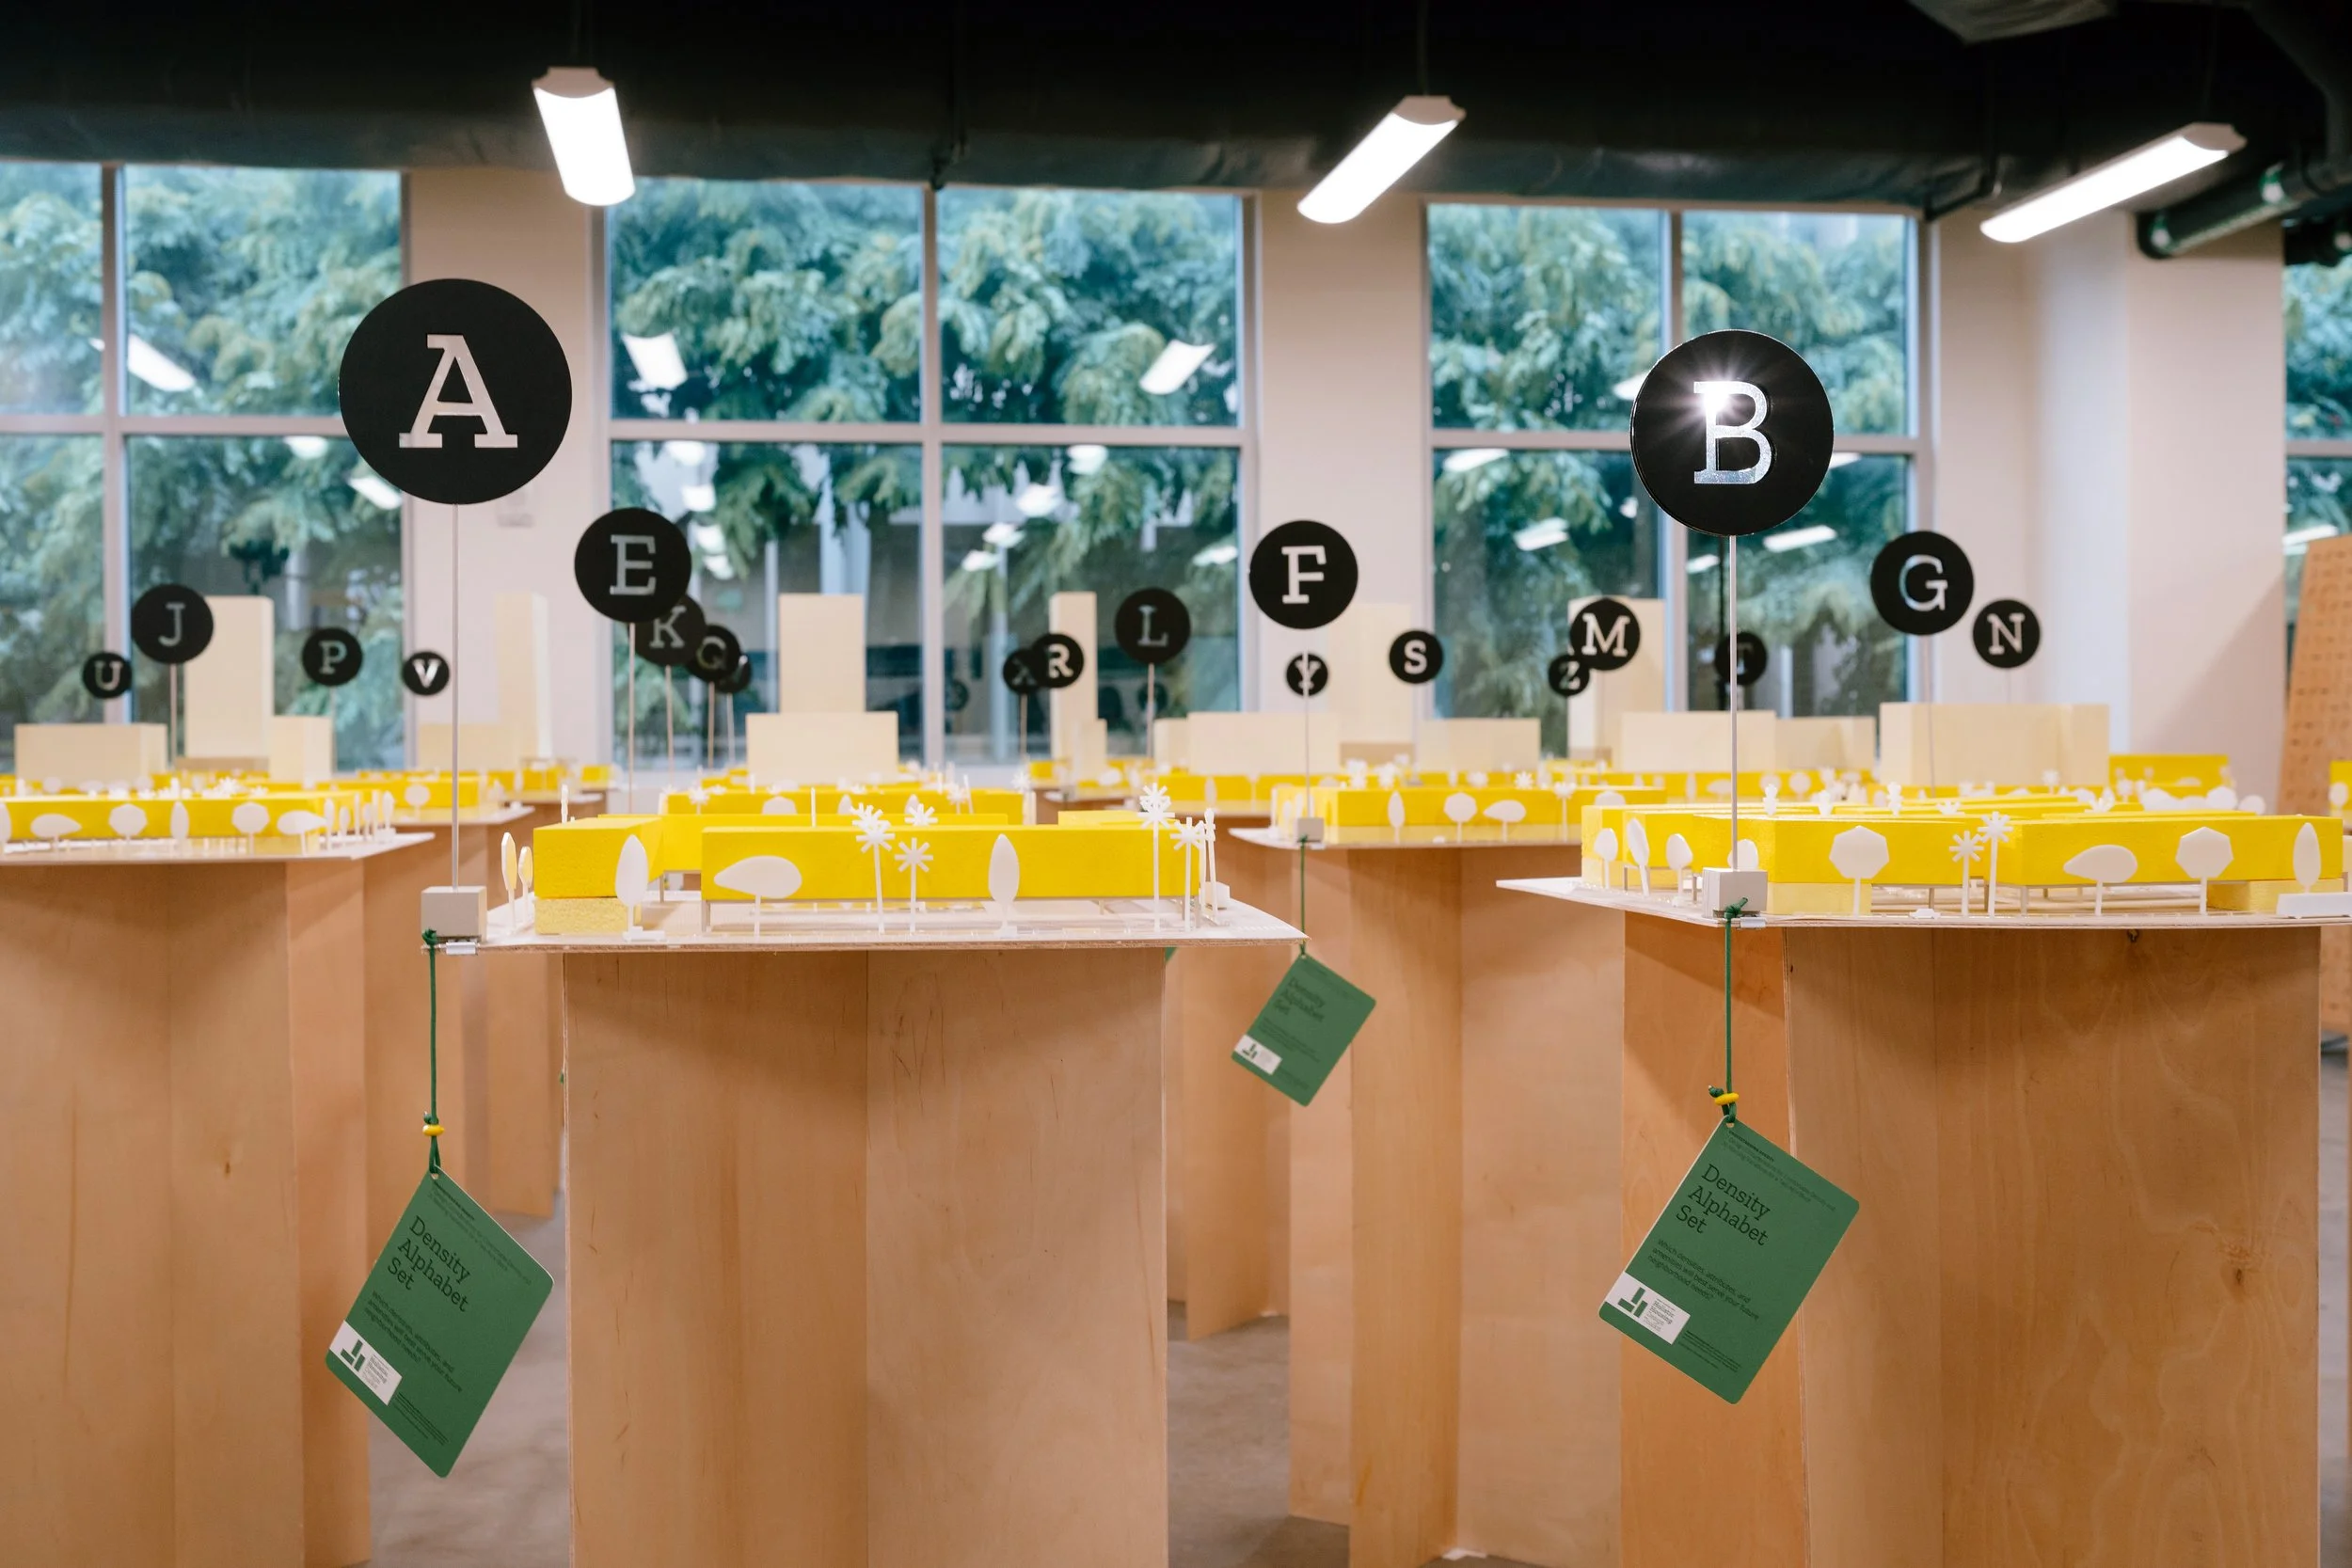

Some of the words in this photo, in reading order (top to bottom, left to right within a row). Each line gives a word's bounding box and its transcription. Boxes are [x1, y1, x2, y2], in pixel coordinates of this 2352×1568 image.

[399, 334, 517, 448] A
[1692, 380, 1773, 486] B
[610, 534, 657, 595] E
[1281, 546, 1327, 604] F
[1899, 554, 1949, 612] G
[158, 603, 185, 647] J
[649, 605, 687, 648] K
[1138, 606, 1168, 646] L
[1581, 612, 1630, 657] M
[1988, 612, 2026, 655] N
[95, 661, 122, 691] U
[319, 640, 347, 673] P
[413, 660, 440, 688] V
[1043, 643, 1073, 678] R
[1404, 641, 1427, 674] S
[1702, 1164, 1771, 1221] Density
[1677, 1205, 1707, 1233] Set
[1688, 1186, 1768, 1245] Alphabet
[410, 1216, 470, 1284] Density
[388, 1258, 414, 1290] Set
[398, 1239, 468, 1312] Alphabet
